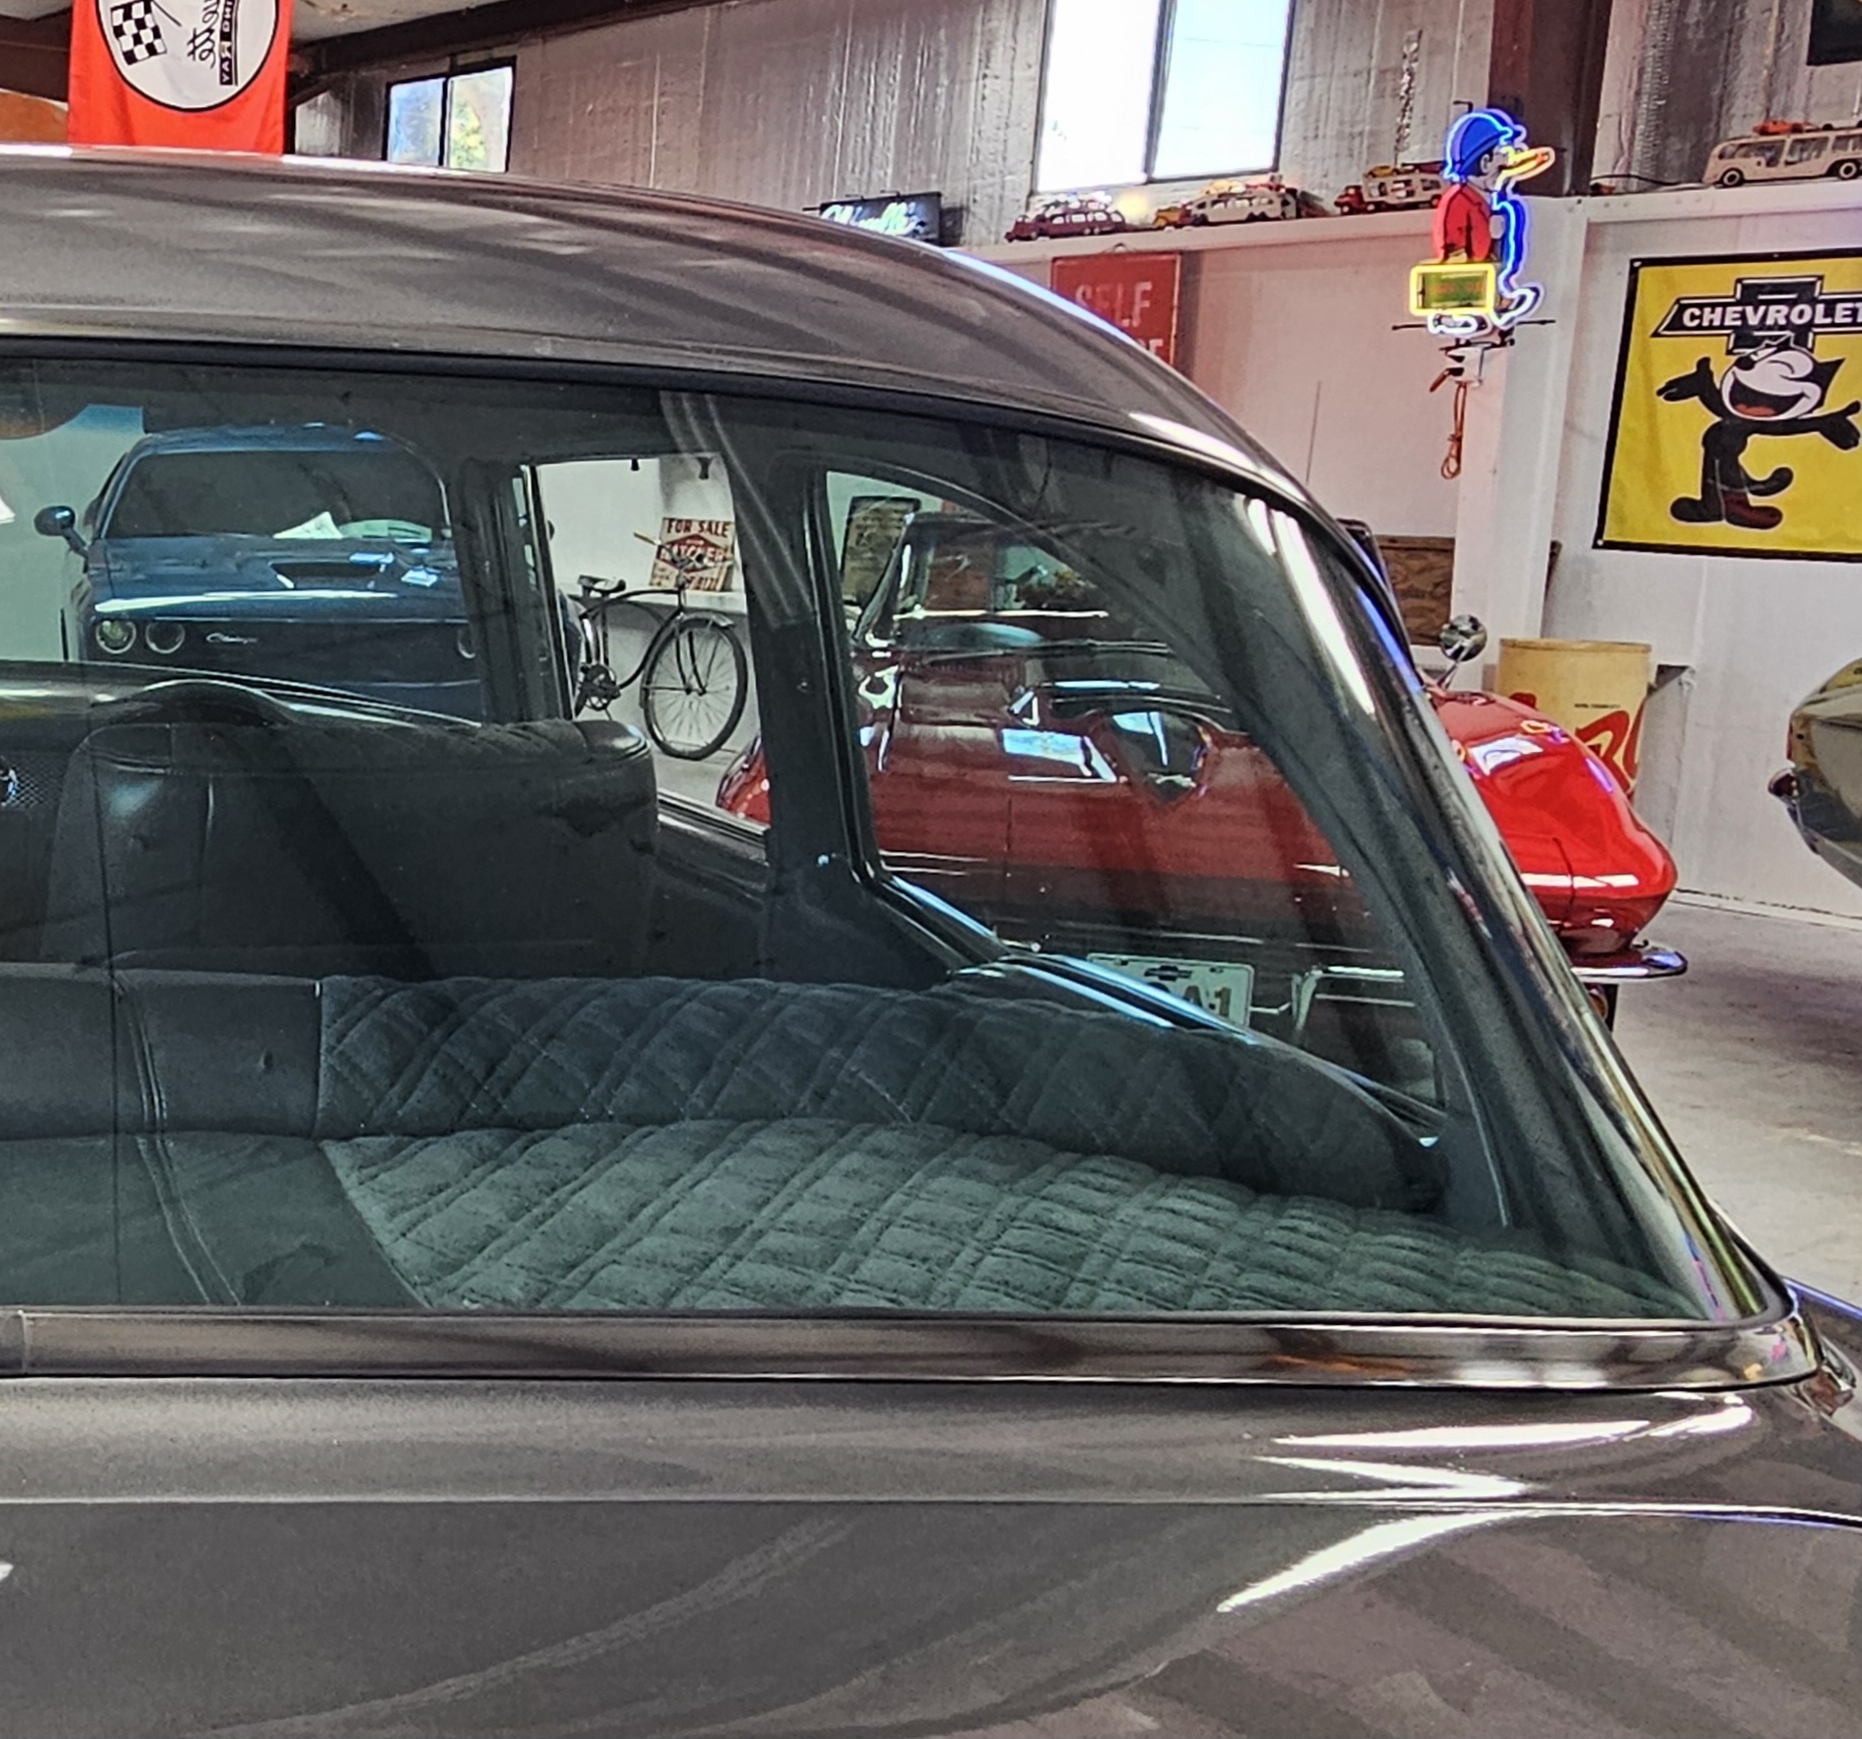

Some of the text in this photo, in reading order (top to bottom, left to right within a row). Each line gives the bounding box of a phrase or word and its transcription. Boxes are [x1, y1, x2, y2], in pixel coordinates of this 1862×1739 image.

[1682, 301, 1862, 328] CHEVROLET
[666, 519, 730, 539] FOR SALE
